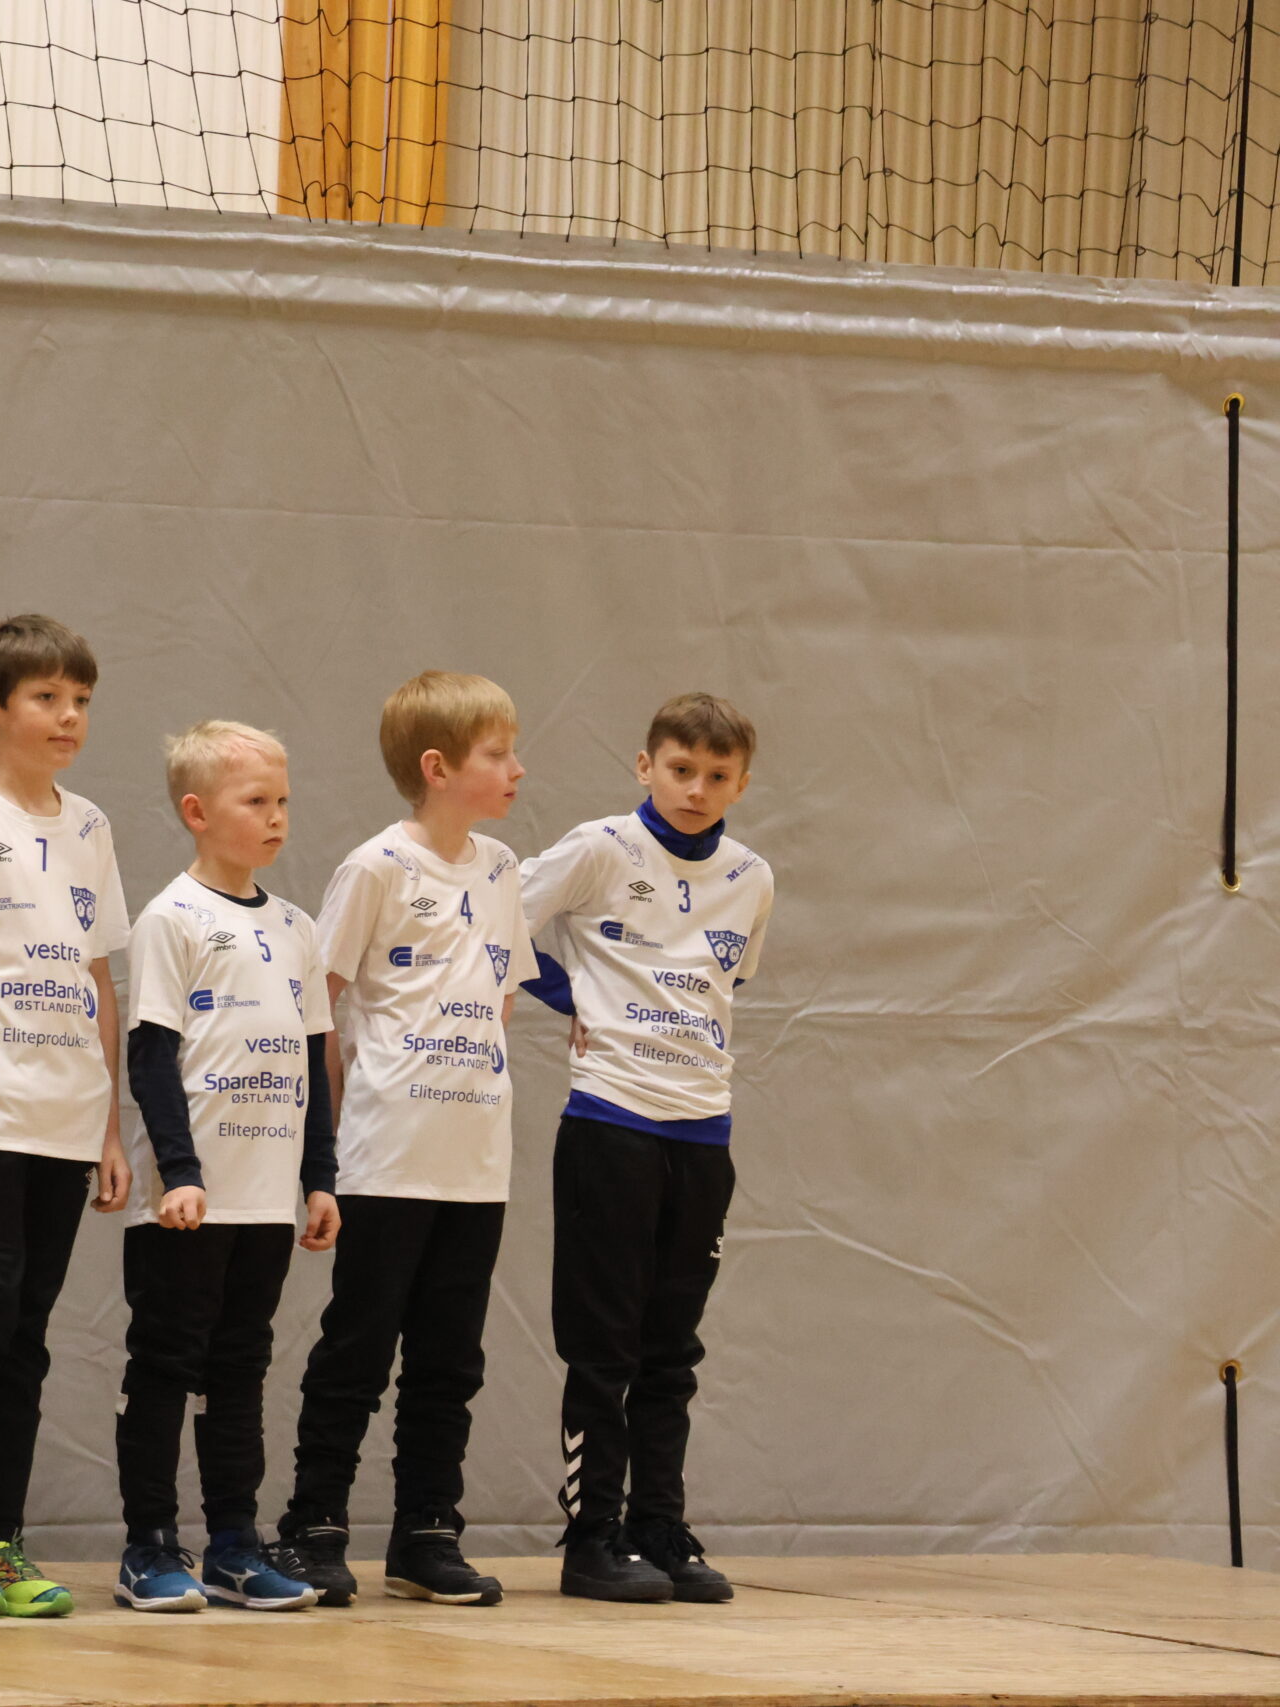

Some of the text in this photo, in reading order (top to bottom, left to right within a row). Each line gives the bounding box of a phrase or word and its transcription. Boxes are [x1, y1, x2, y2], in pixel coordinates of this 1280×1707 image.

[35, 837, 48, 872] 7
[629, 895, 652, 903] umbro
[677, 879, 691, 913] 3
[460, 890, 473, 924] 4
[24, 942, 80, 963] vestre
[213, 944, 237, 952] umbro
[254, 930, 272, 962] 5
[652, 970, 710, 993] vestre
[14, 1000, 83, 1015] ØSTLANDET
[438, 1000, 493, 1021] vestre
[625, 1002, 711, 1032] SpareBank
[245, 1034, 301, 1055] vestre
[403, 1033, 491, 1057] SpareBank
[426, 1054, 489, 1071] ØSTLANDET
[232, 1093, 292, 1104] ØSTLAND
[410, 1084, 501, 1105] Eliteprodukter
